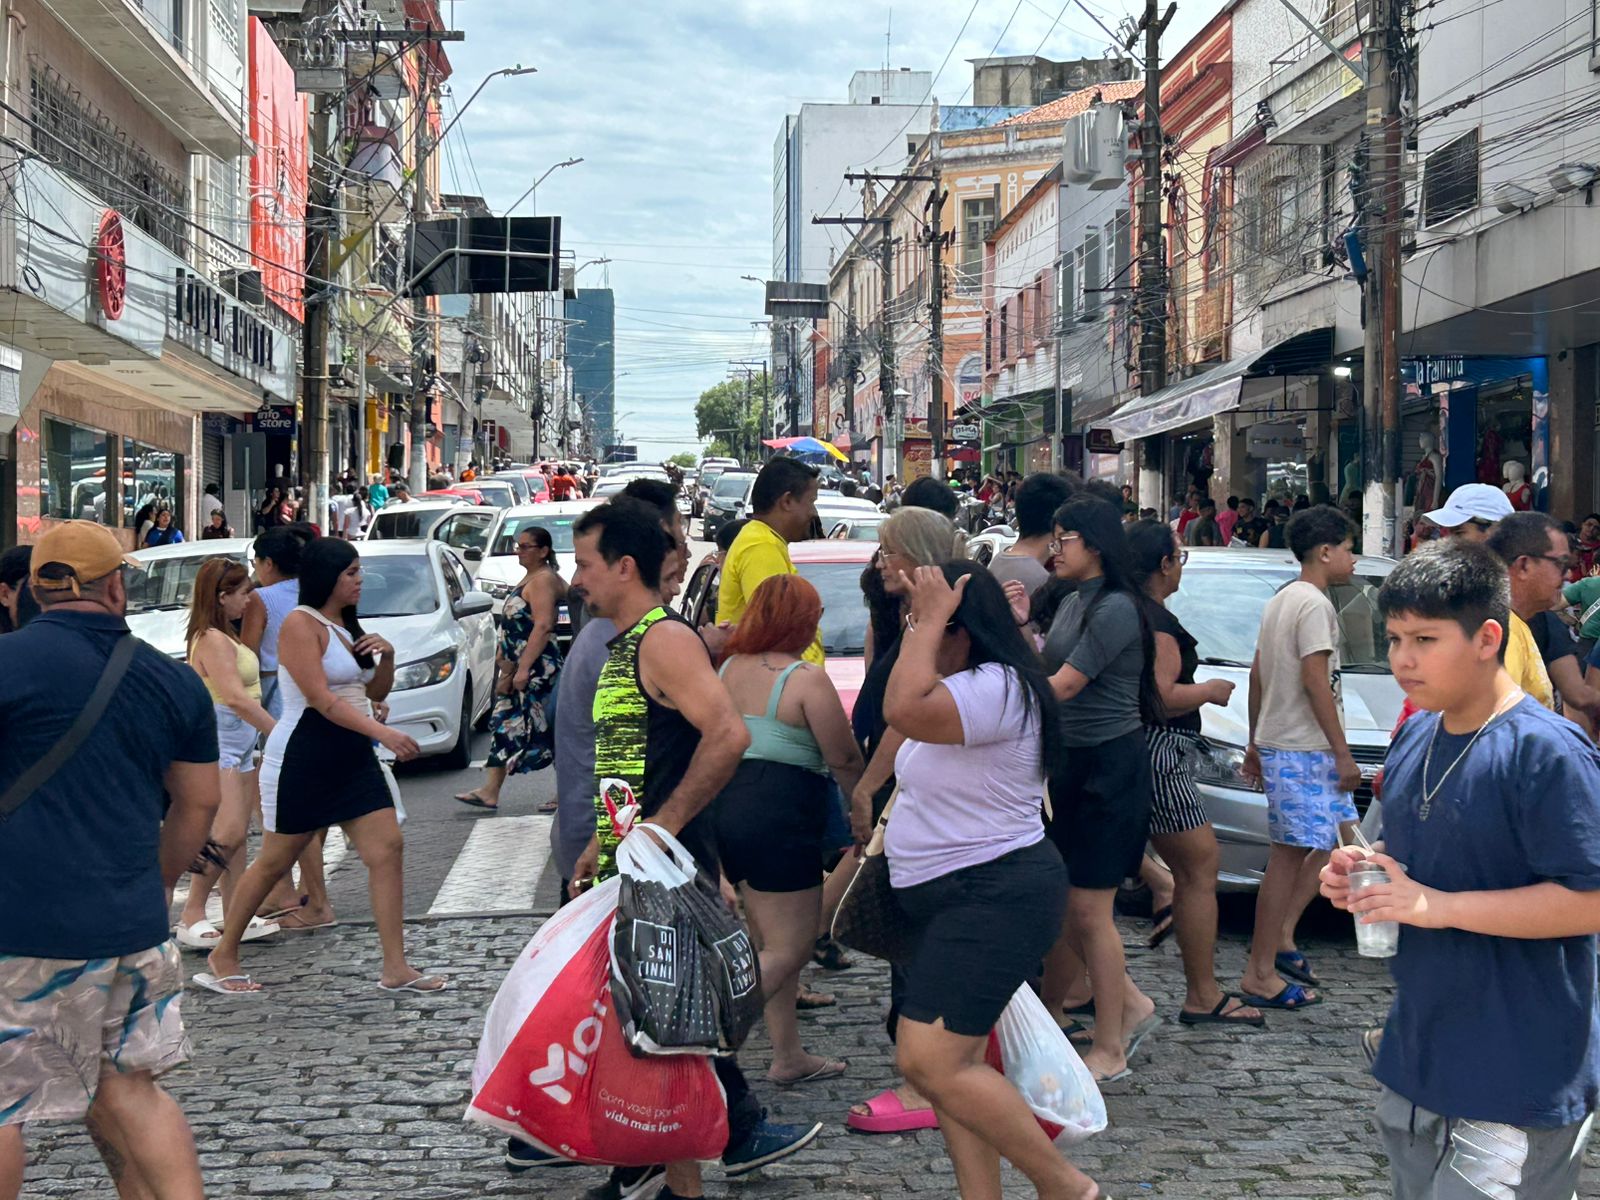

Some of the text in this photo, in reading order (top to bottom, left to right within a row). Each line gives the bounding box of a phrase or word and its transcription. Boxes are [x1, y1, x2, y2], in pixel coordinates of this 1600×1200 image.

[232, 305, 273, 371] HOTEL
[259, 419, 292, 428] store
[660, 930, 672, 946] DI
[733, 937, 747, 952] DI
[648, 944, 672, 962] SAN
[605, 1109, 629, 1125] vida
[630, 1119, 657, 1132] mais
